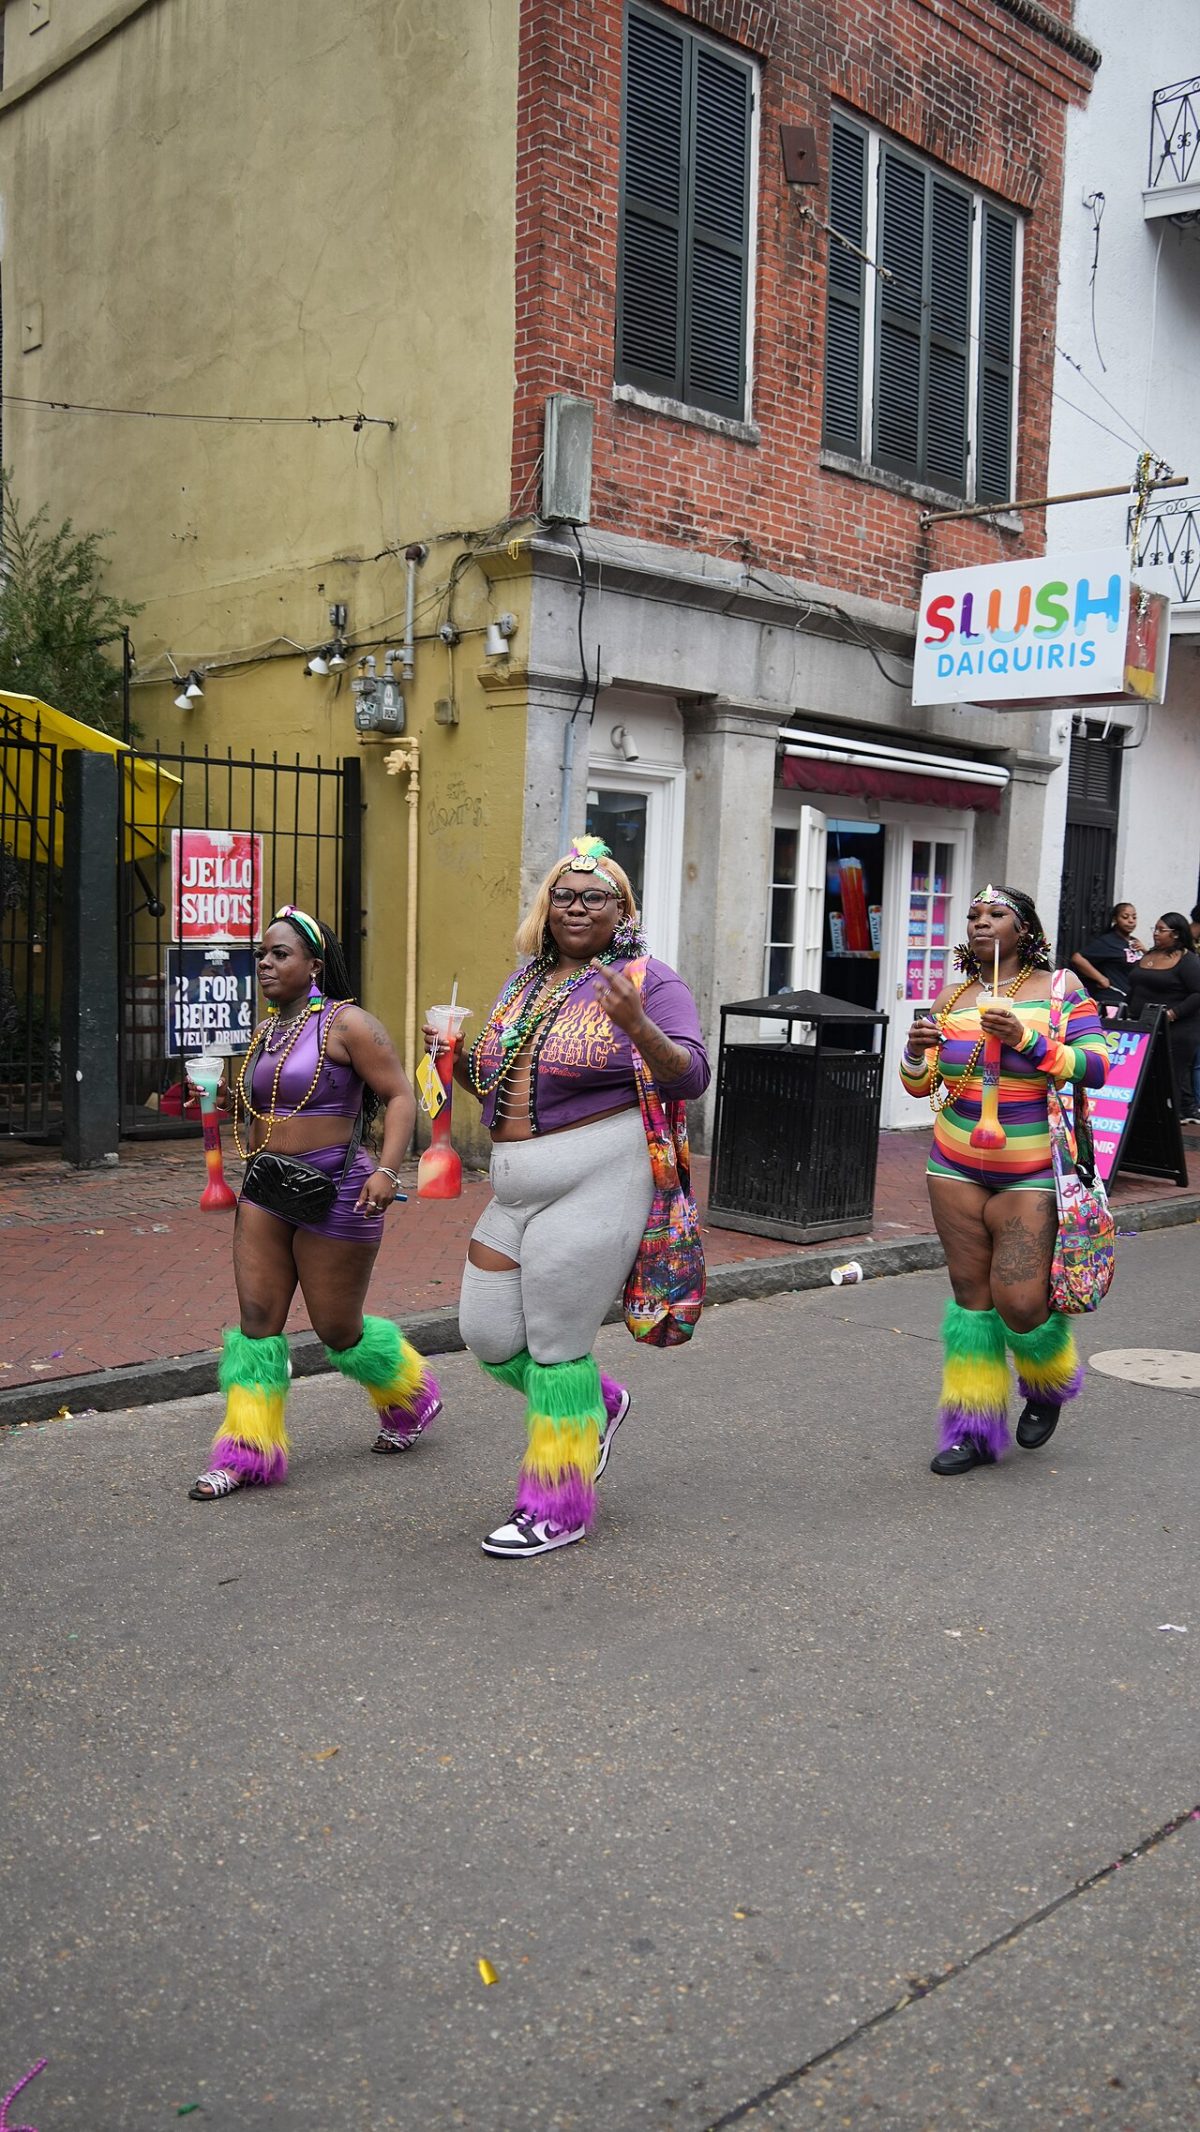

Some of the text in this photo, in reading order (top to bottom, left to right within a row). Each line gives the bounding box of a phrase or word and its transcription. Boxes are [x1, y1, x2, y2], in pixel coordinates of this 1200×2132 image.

[924, 574, 1121, 650] SLUSH
[937, 641, 1096, 678] DAIQUIRIS
[182, 857, 252, 887] JELLO
[181, 893, 252, 924] SHOTS
[174, 976, 189, 1002] 2
[199, 976, 238, 1002] FOR
[174, 1002, 252, 1029] BEER &
[174, 1029, 252, 1046] WELL DRINKS
[1092, 1117, 1121, 1131] HOTS
